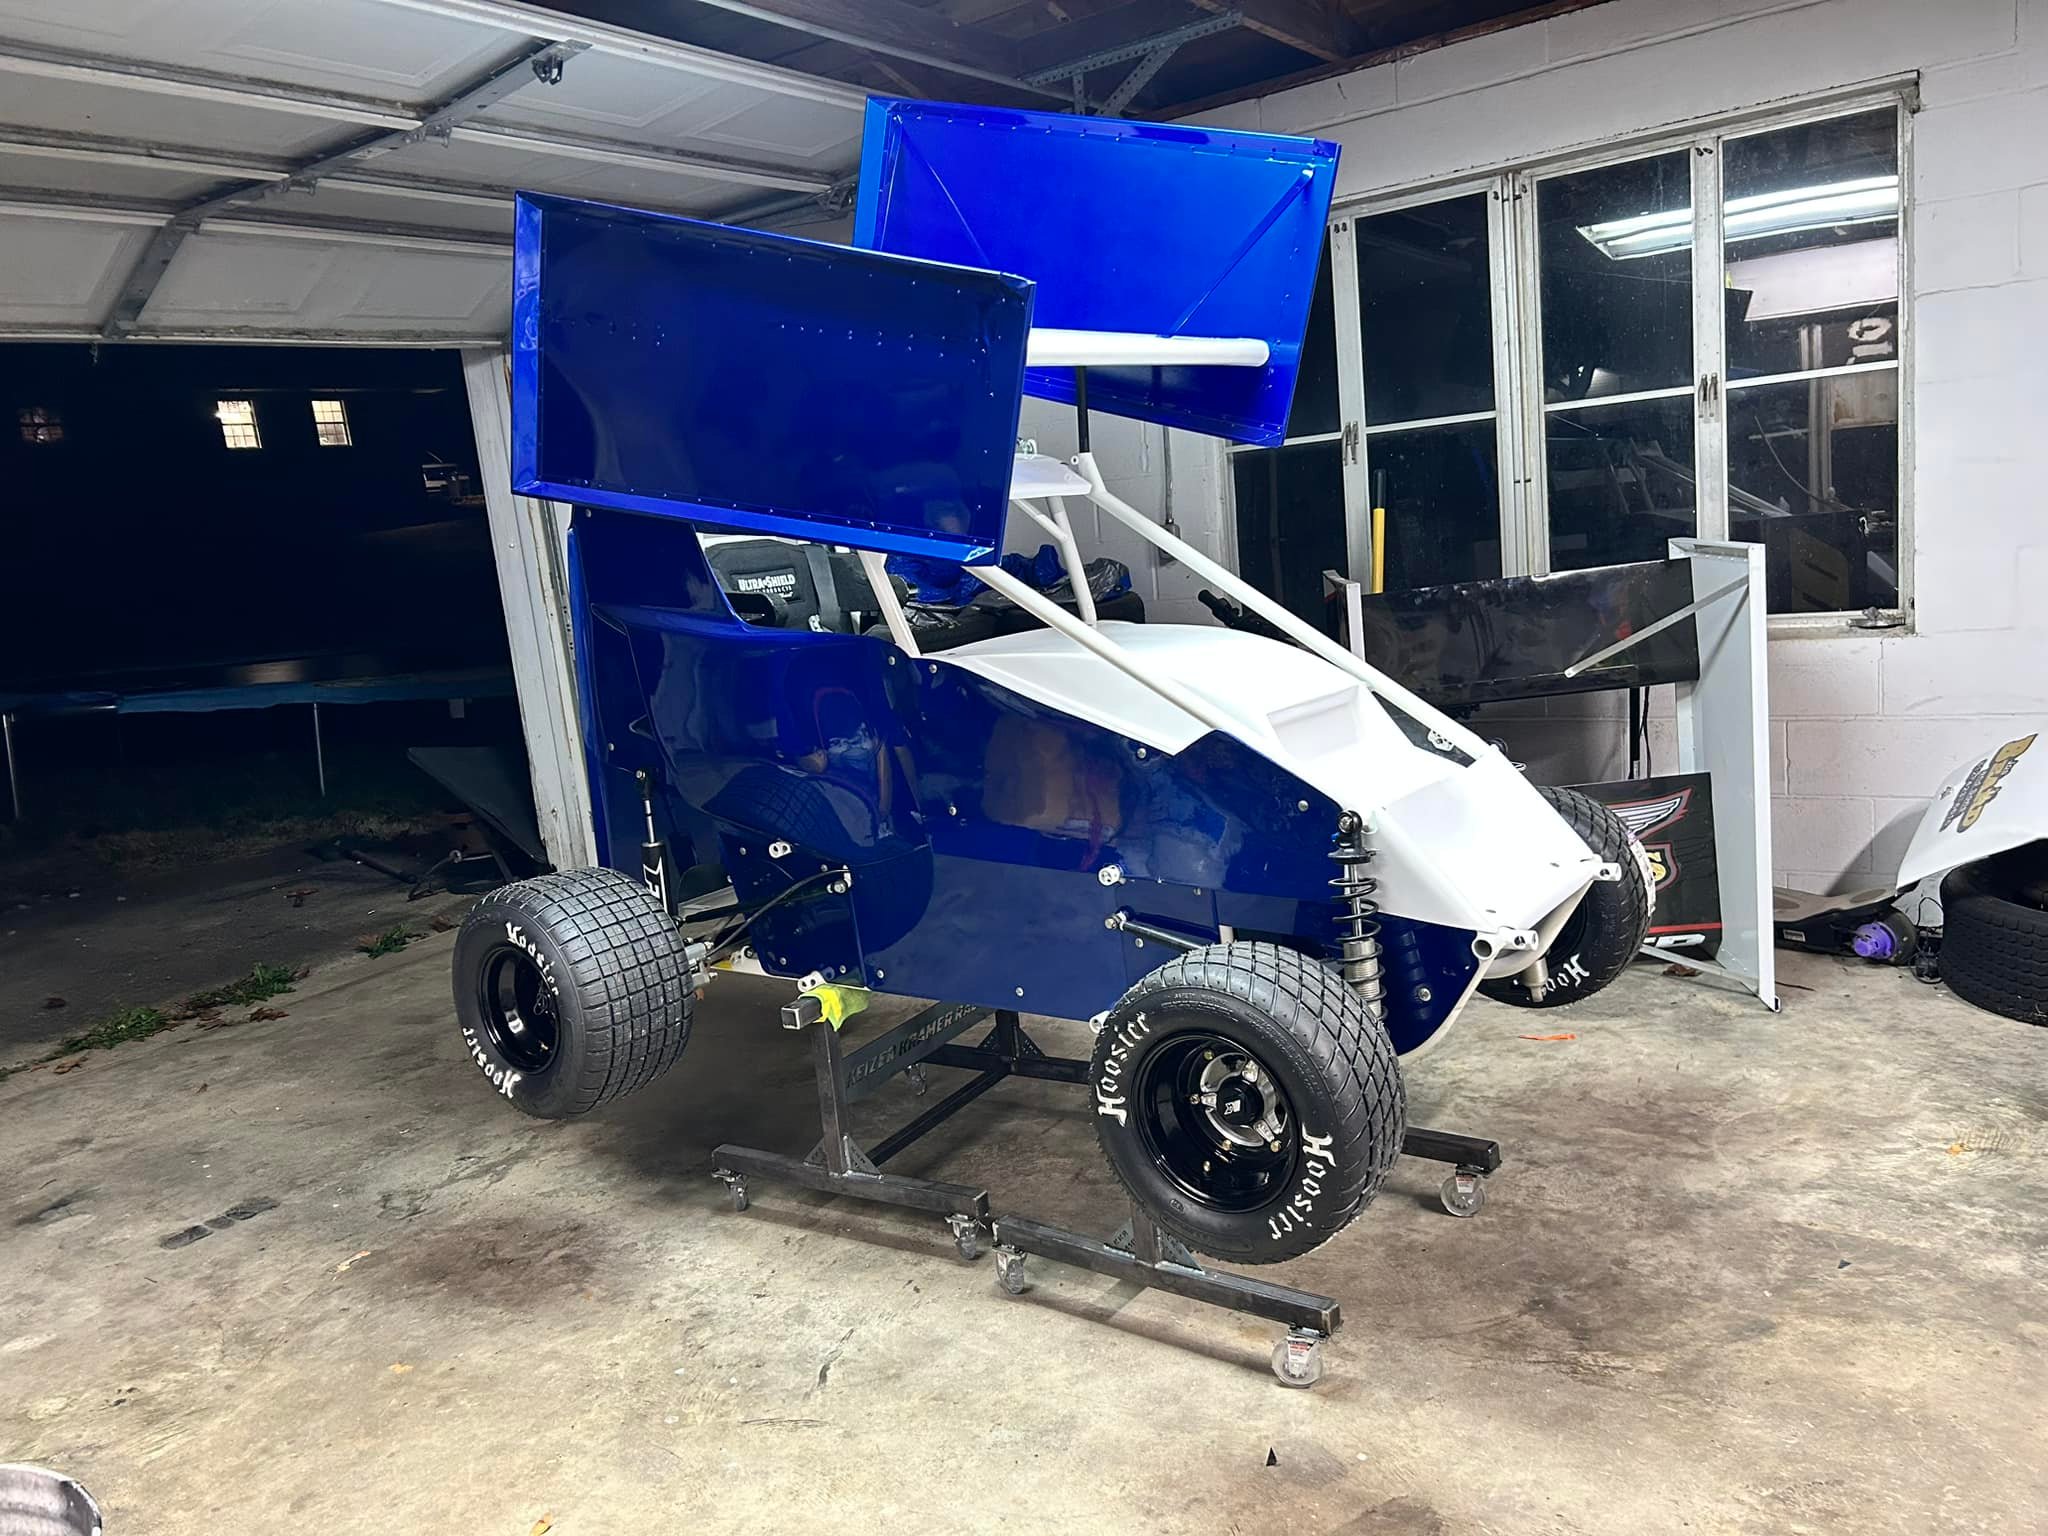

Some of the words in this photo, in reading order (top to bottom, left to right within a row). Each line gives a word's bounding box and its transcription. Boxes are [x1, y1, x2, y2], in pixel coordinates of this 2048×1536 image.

[738, 578, 765, 592] ULTRA
[765, 574, 796, 588] SHIELD
[505, 921, 560, 997] Hoosier
[462, 1026, 522, 1099] Hoosier
[1096, 1010, 1151, 1128] Hoosier
[1267, 1123, 1337, 1240] Hoosier
